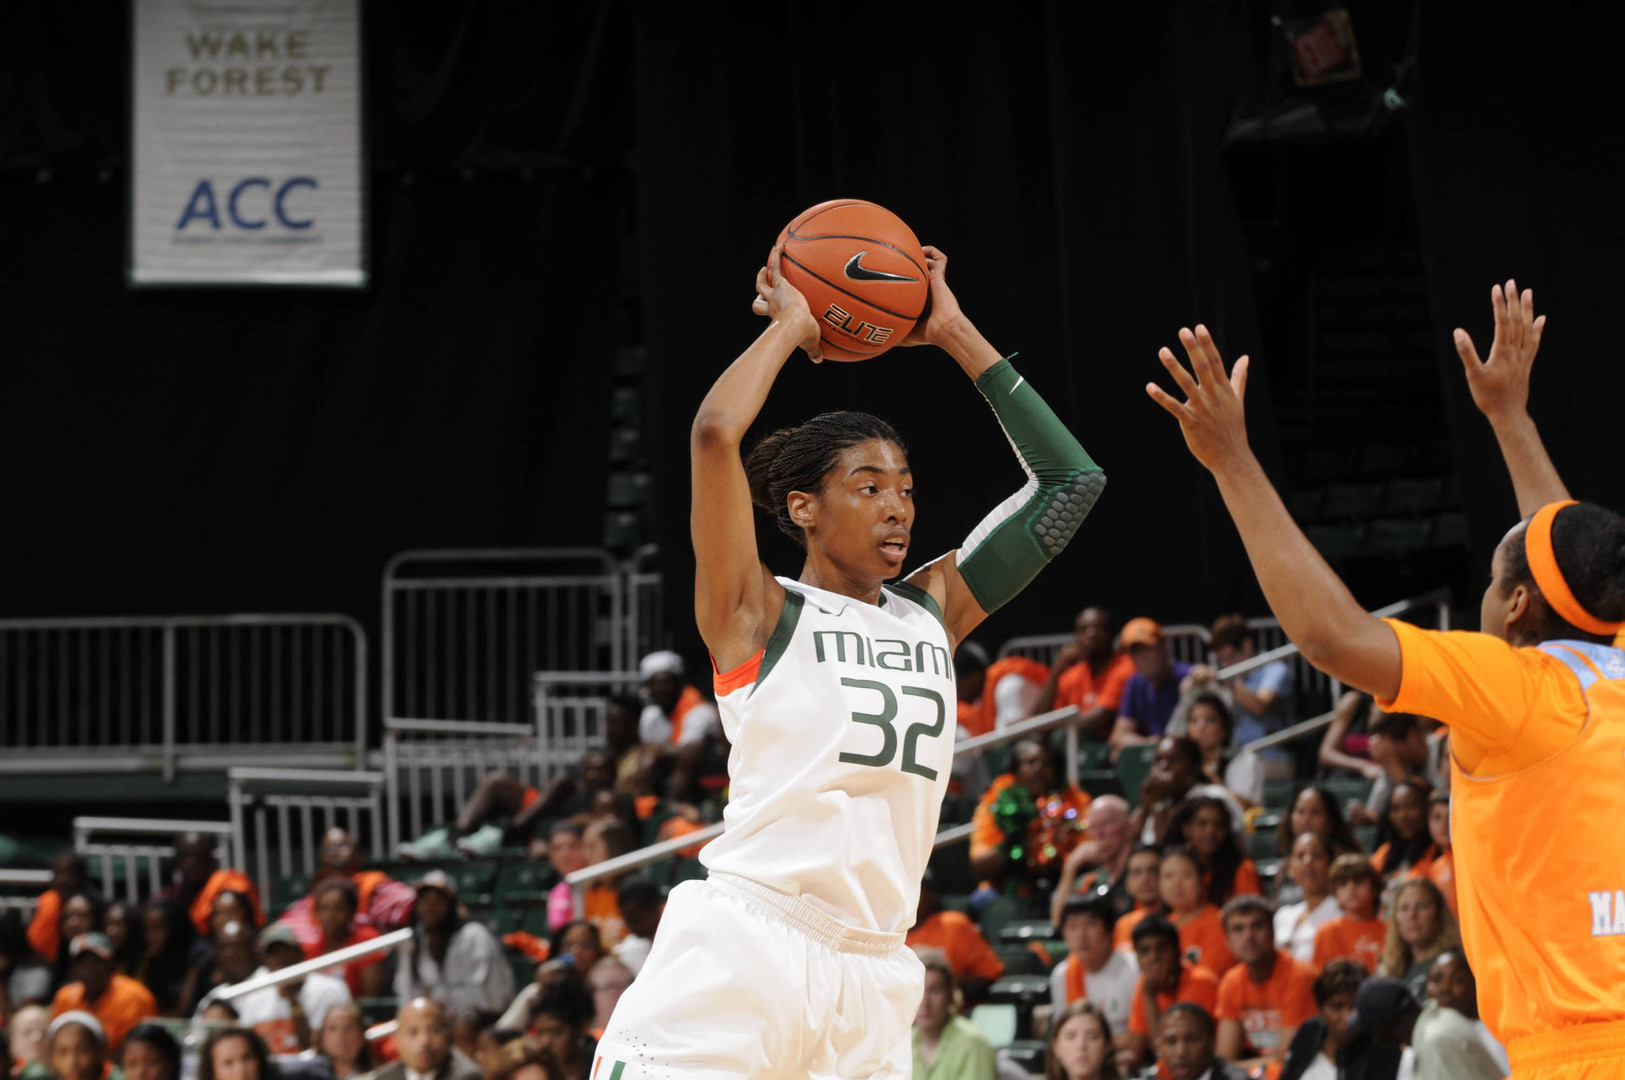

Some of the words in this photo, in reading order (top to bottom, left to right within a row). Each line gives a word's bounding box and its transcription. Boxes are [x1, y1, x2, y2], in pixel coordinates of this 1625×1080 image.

[185, 31, 309, 60] WAKE
[165, 65, 332, 96] FOREST
[175, 176, 319, 231] ACC
[823, 303, 893, 343] ELITE
[838, 677, 946, 782] 32
